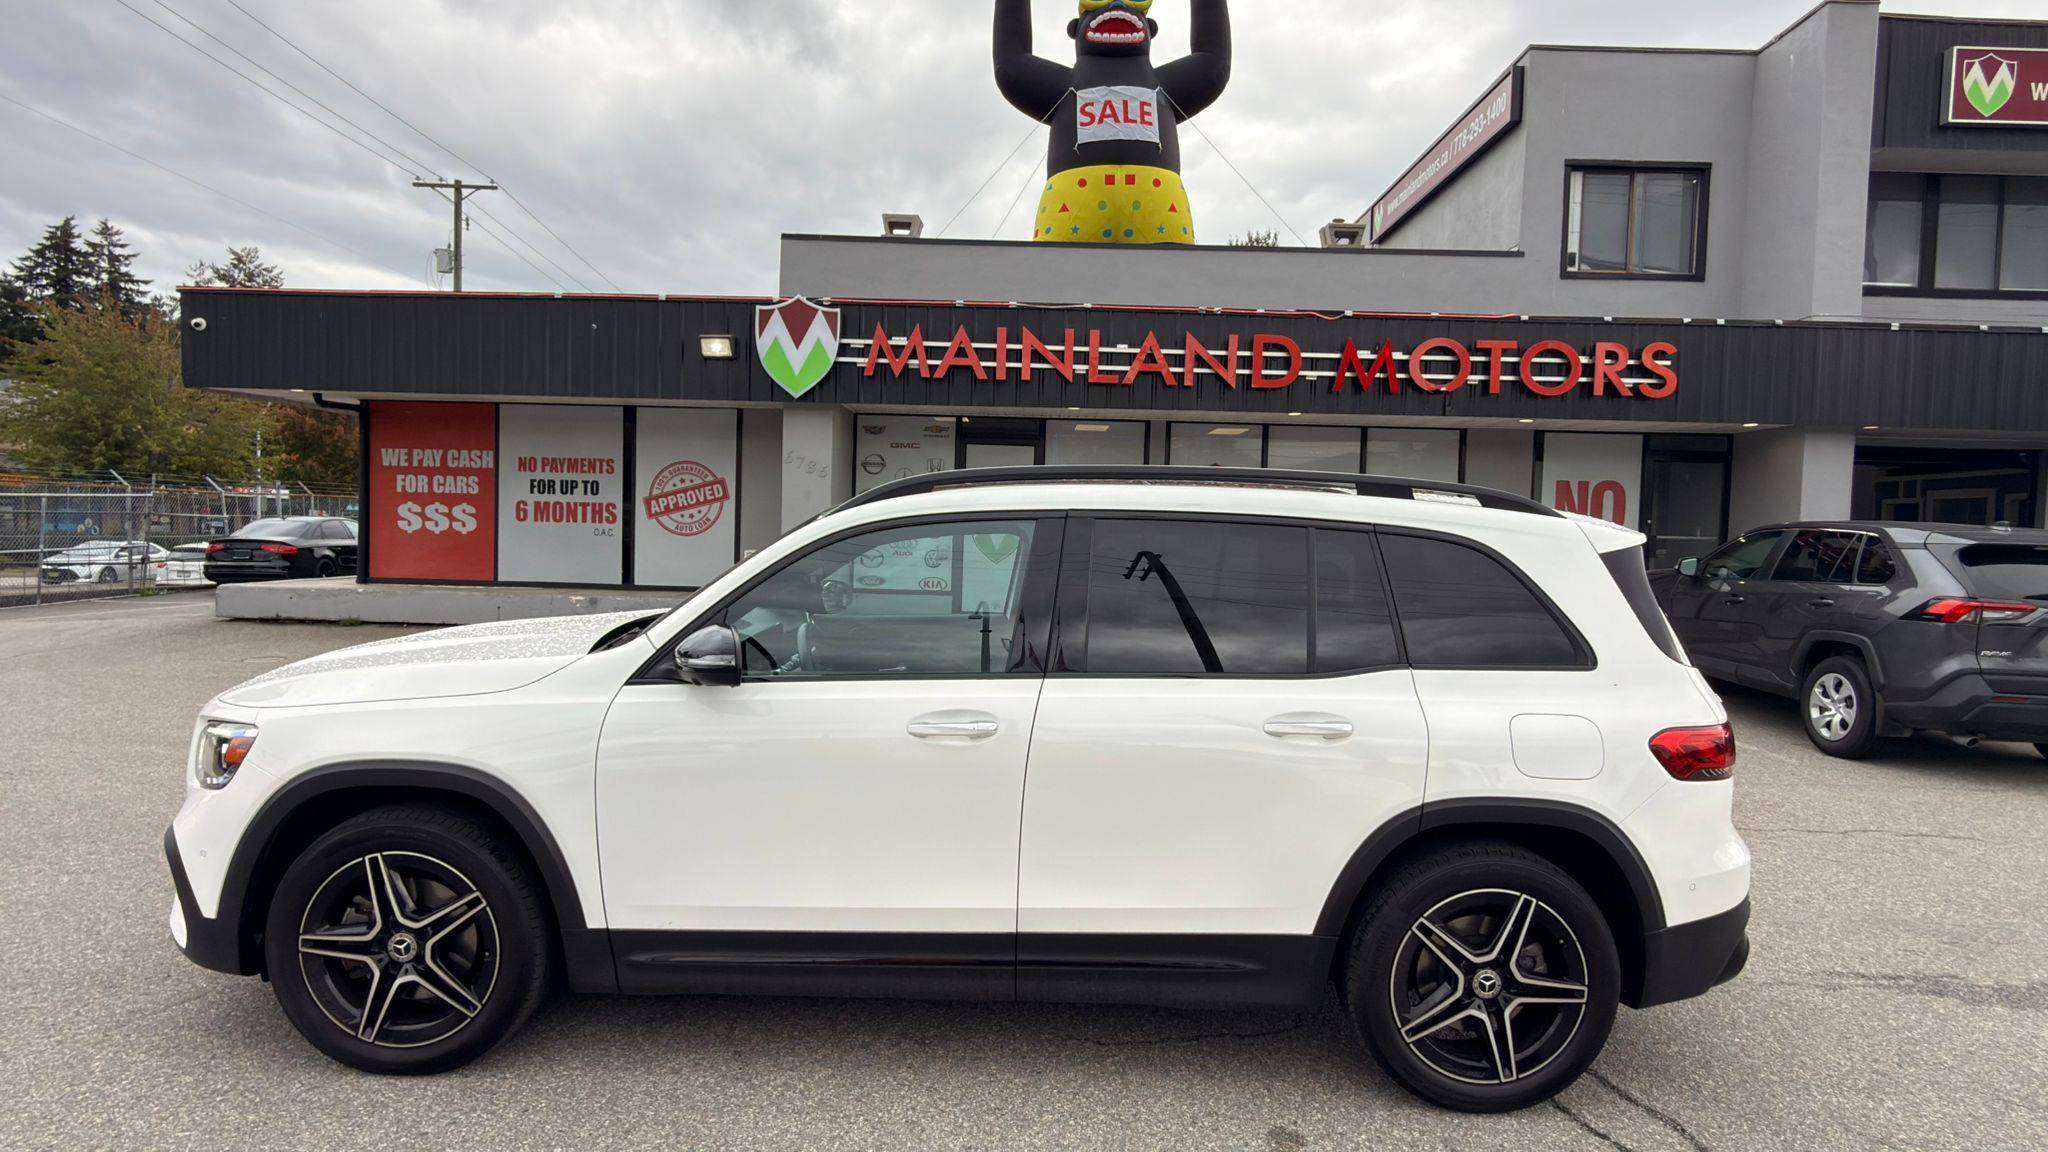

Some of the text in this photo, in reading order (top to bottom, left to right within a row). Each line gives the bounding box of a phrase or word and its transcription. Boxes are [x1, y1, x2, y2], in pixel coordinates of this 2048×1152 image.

[1079, 99, 1153, 127] SALE
[864, 321, 1301, 390] MAINLAND
[1332, 337, 1678, 398] MOTORS
[381, 448, 494, 469] WE PAY CASH
[518, 456, 616, 475] NO PAYMENTS
[396, 474, 479, 494] FOR CARS
[530, 479, 600, 496] FOR UP TO
[651, 484, 723, 514] APPROVED
[1554, 480, 1626, 526] NO
[397, 501, 478, 534] $$$
[515, 500, 617, 525] 6 MONTHS
[694, 516, 712, 531] LOAN
[923, 580, 943, 588] KIA
